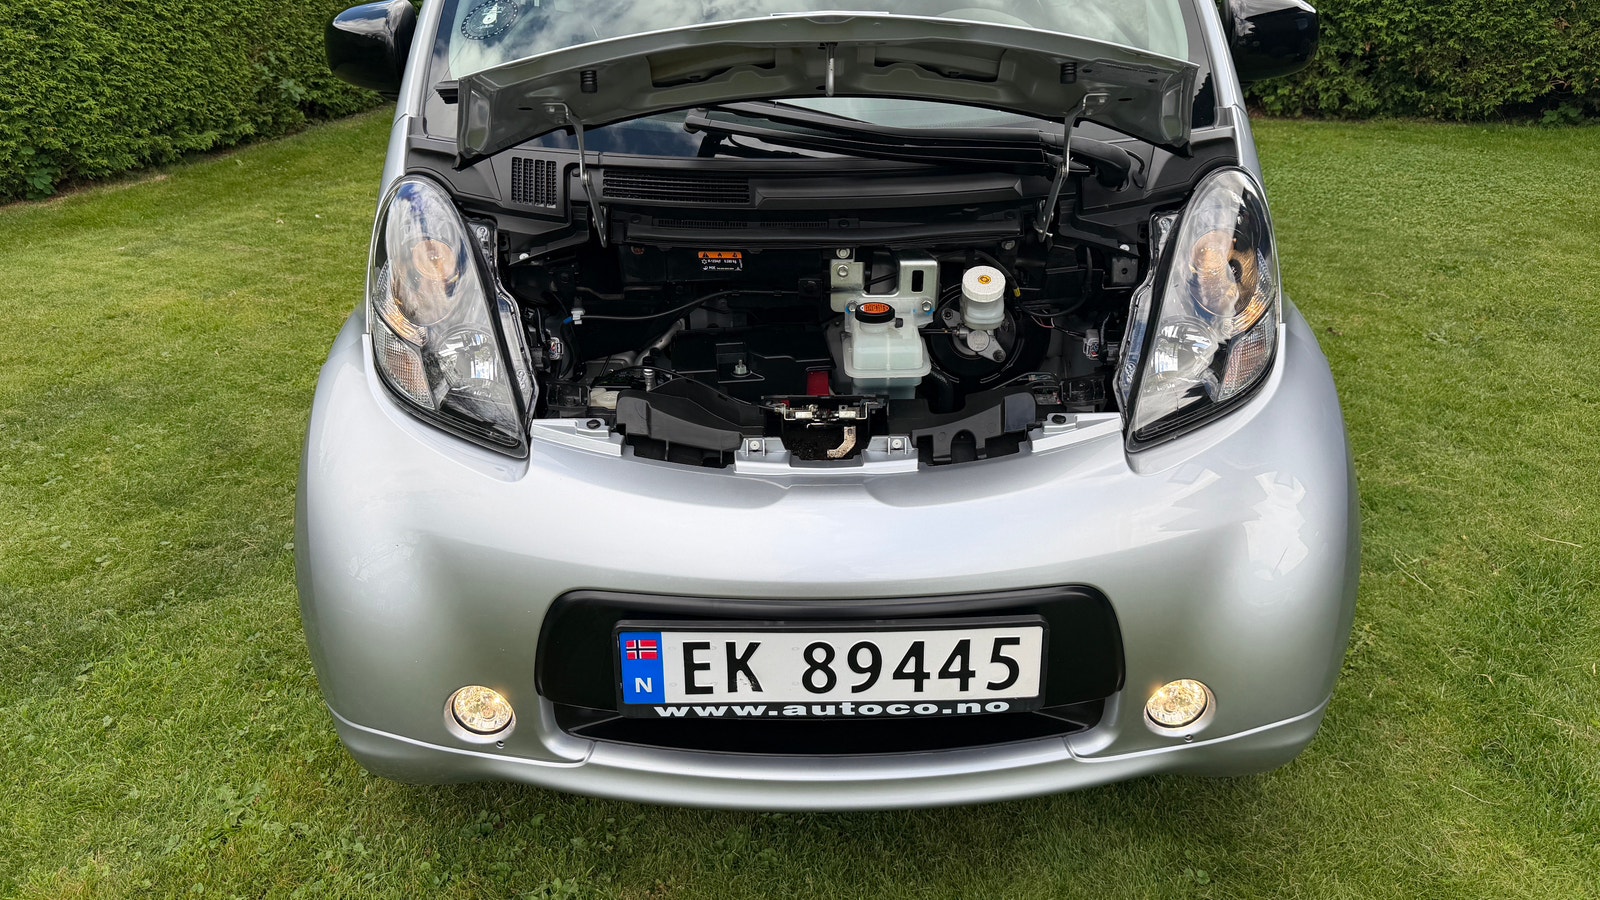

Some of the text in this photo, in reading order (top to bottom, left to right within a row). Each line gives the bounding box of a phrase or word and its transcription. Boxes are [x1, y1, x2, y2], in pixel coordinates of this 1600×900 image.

[682, 636, 1021, 695] EK 89445
[634, 677, 653, 693] N
[653, 700, 1010, 718] www.autoco.no
